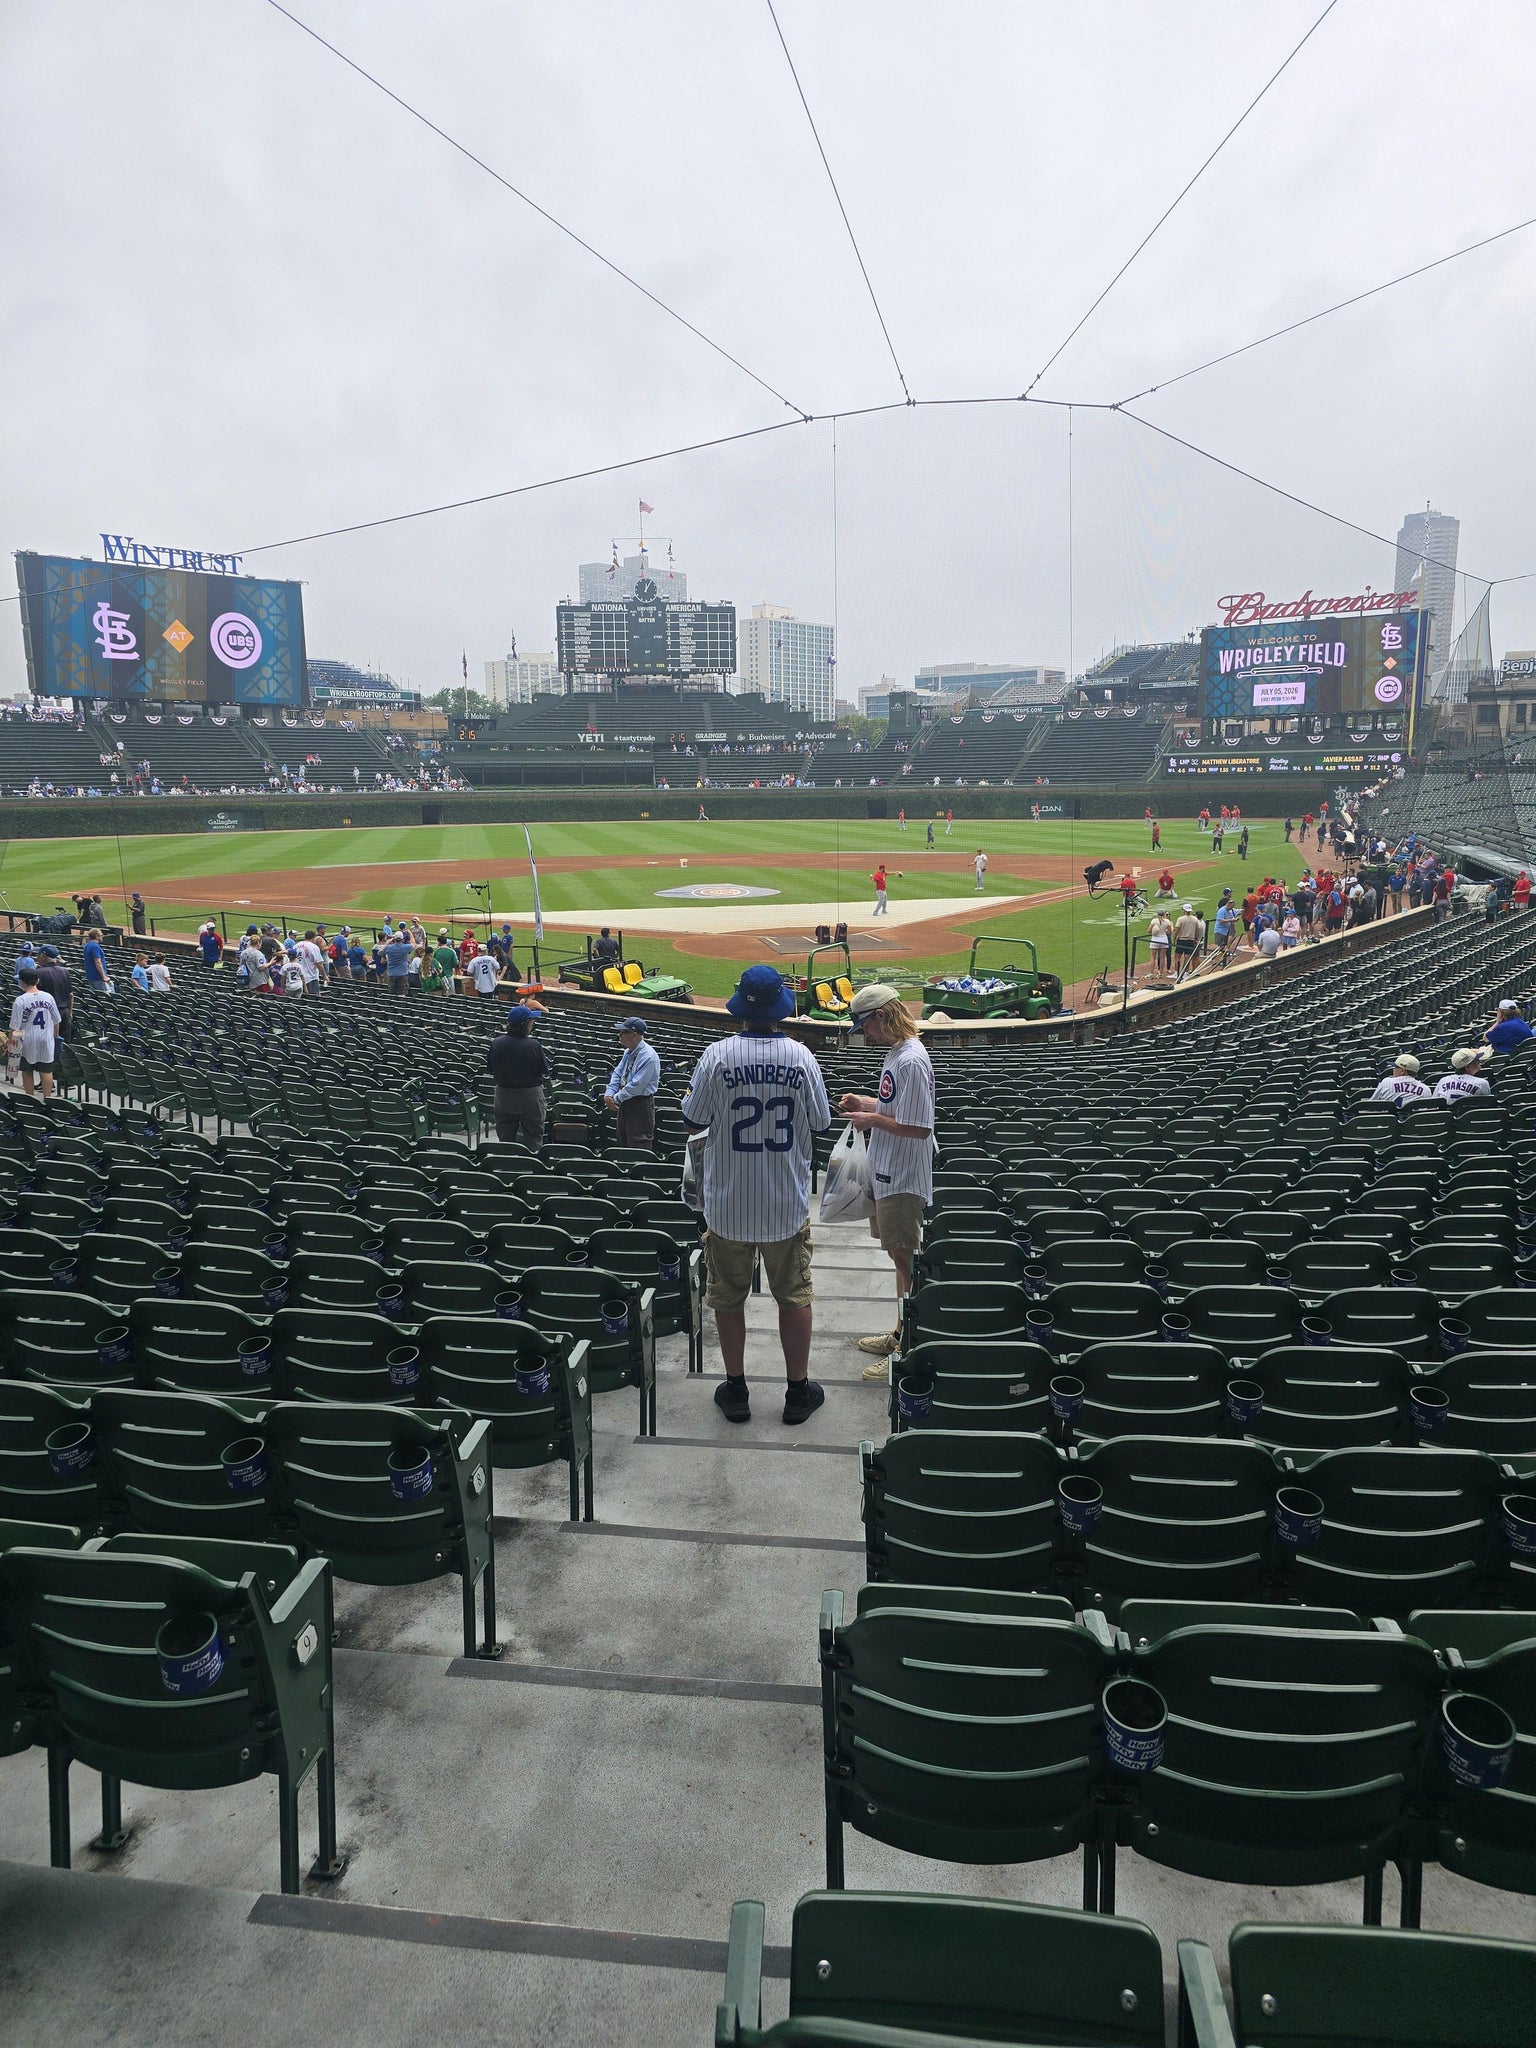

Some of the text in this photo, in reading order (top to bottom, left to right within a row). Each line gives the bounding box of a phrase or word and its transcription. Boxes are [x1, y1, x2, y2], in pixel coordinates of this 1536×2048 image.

[99, 533, 243, 575] WINTRUST
[665, 604, 702, 612] AMERICAN
[1217, 585, 1418, 626] Budweiser
[169, 631, 187, 641] AT
[1248, 634, 1317, 646] WELCOME TO
[1219, 641, 1346, 675] WRIGLEY FIELD
[329, 688, 401, 699] WRIGLEYROOFTOPS.COM
[577, 733, 604, 743] YETI
[804, 732, 837, 740] Advocate
[207, 818, 238, 826] Gallagher
[481, 964, 488, 974] 2
[33, 1011, 45, 1029] 4
[723, 1063, 804, 1090] SANDBERG
[1394, 1082, 1424, 1095] RIZZO
[1441, 1081, 1479, 1096] SWANSON
[730, 1096, 795, 1153] 23
[304, 1635, 311, 1655] 9
[1109, 1735, 1133, 1757] Hefty
[1130, 1738, 1158, 1748] Hefty
[1116, 1755, 1146, 1769] Hefty
